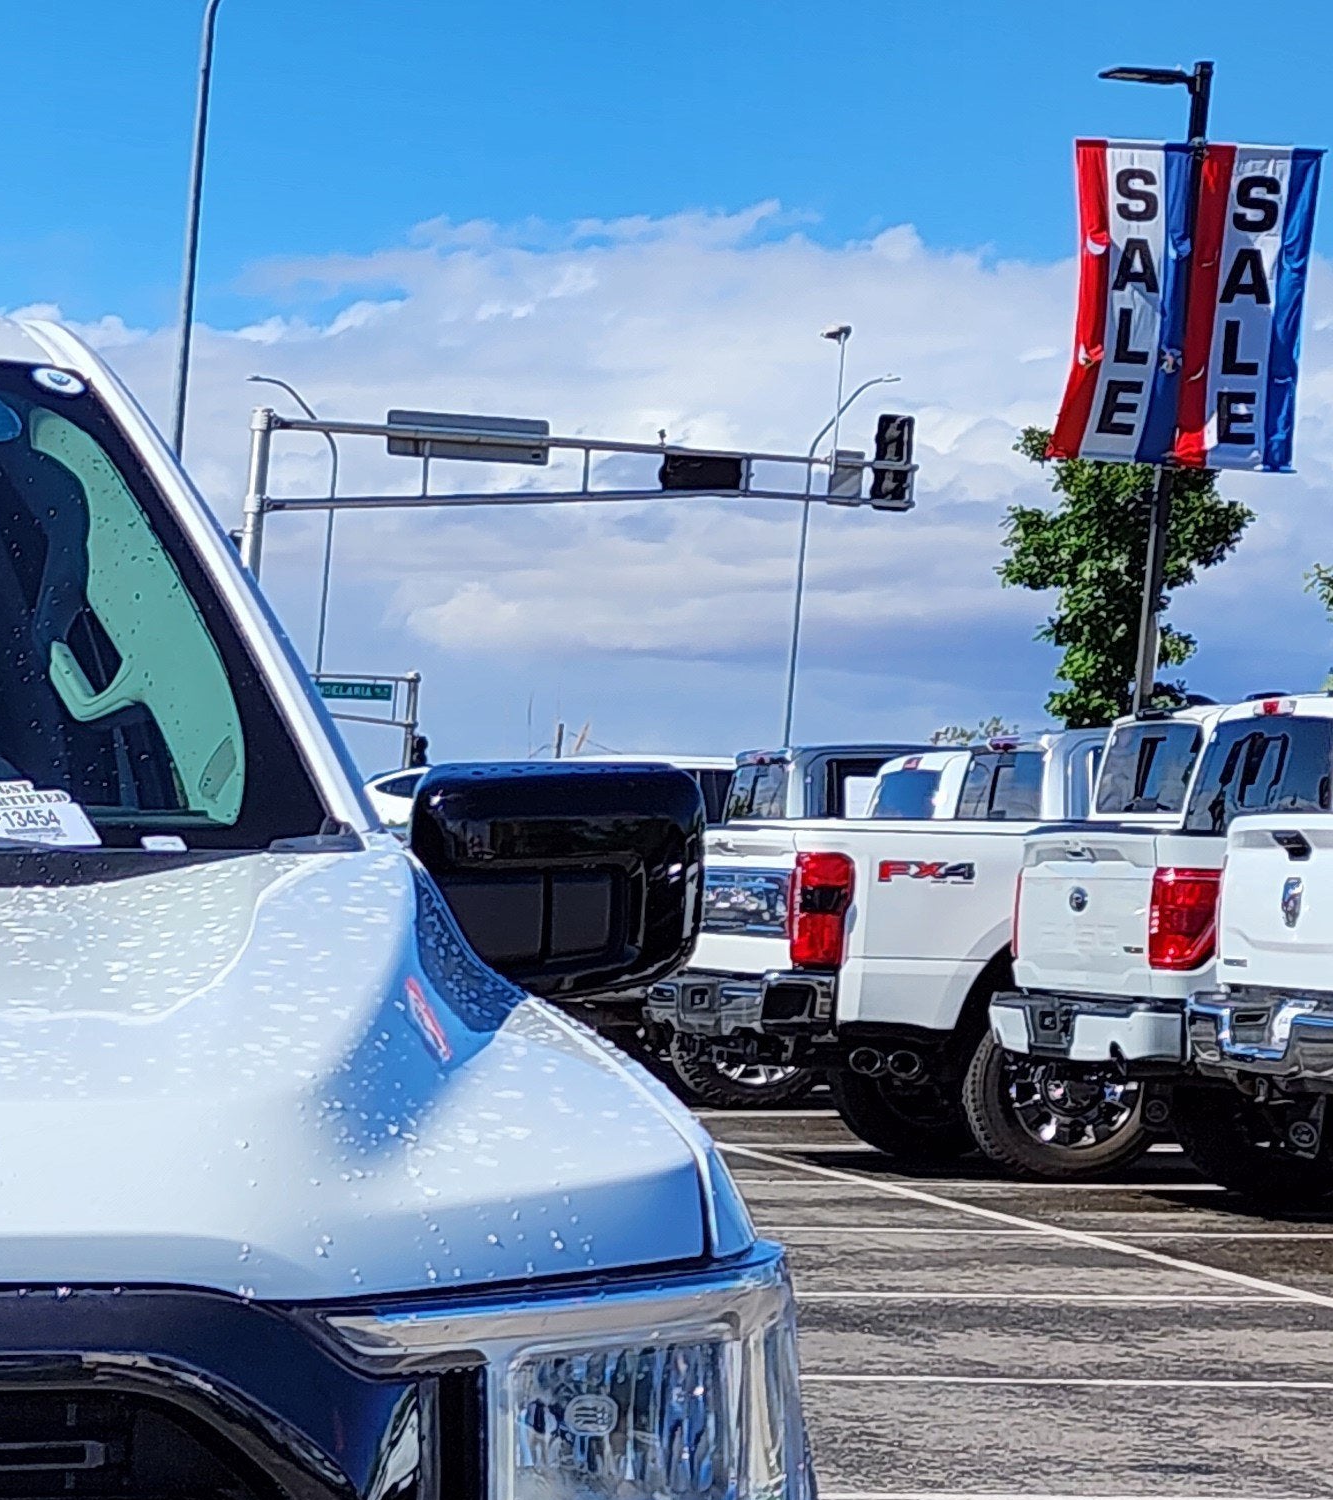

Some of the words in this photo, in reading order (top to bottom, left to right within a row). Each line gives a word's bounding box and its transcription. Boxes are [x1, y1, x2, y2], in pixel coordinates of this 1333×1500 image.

[1095, 168, 1160, 436] SALE
[1218, 175, 1282, 445] SALE
[877, 860, 975, 882] FX4
